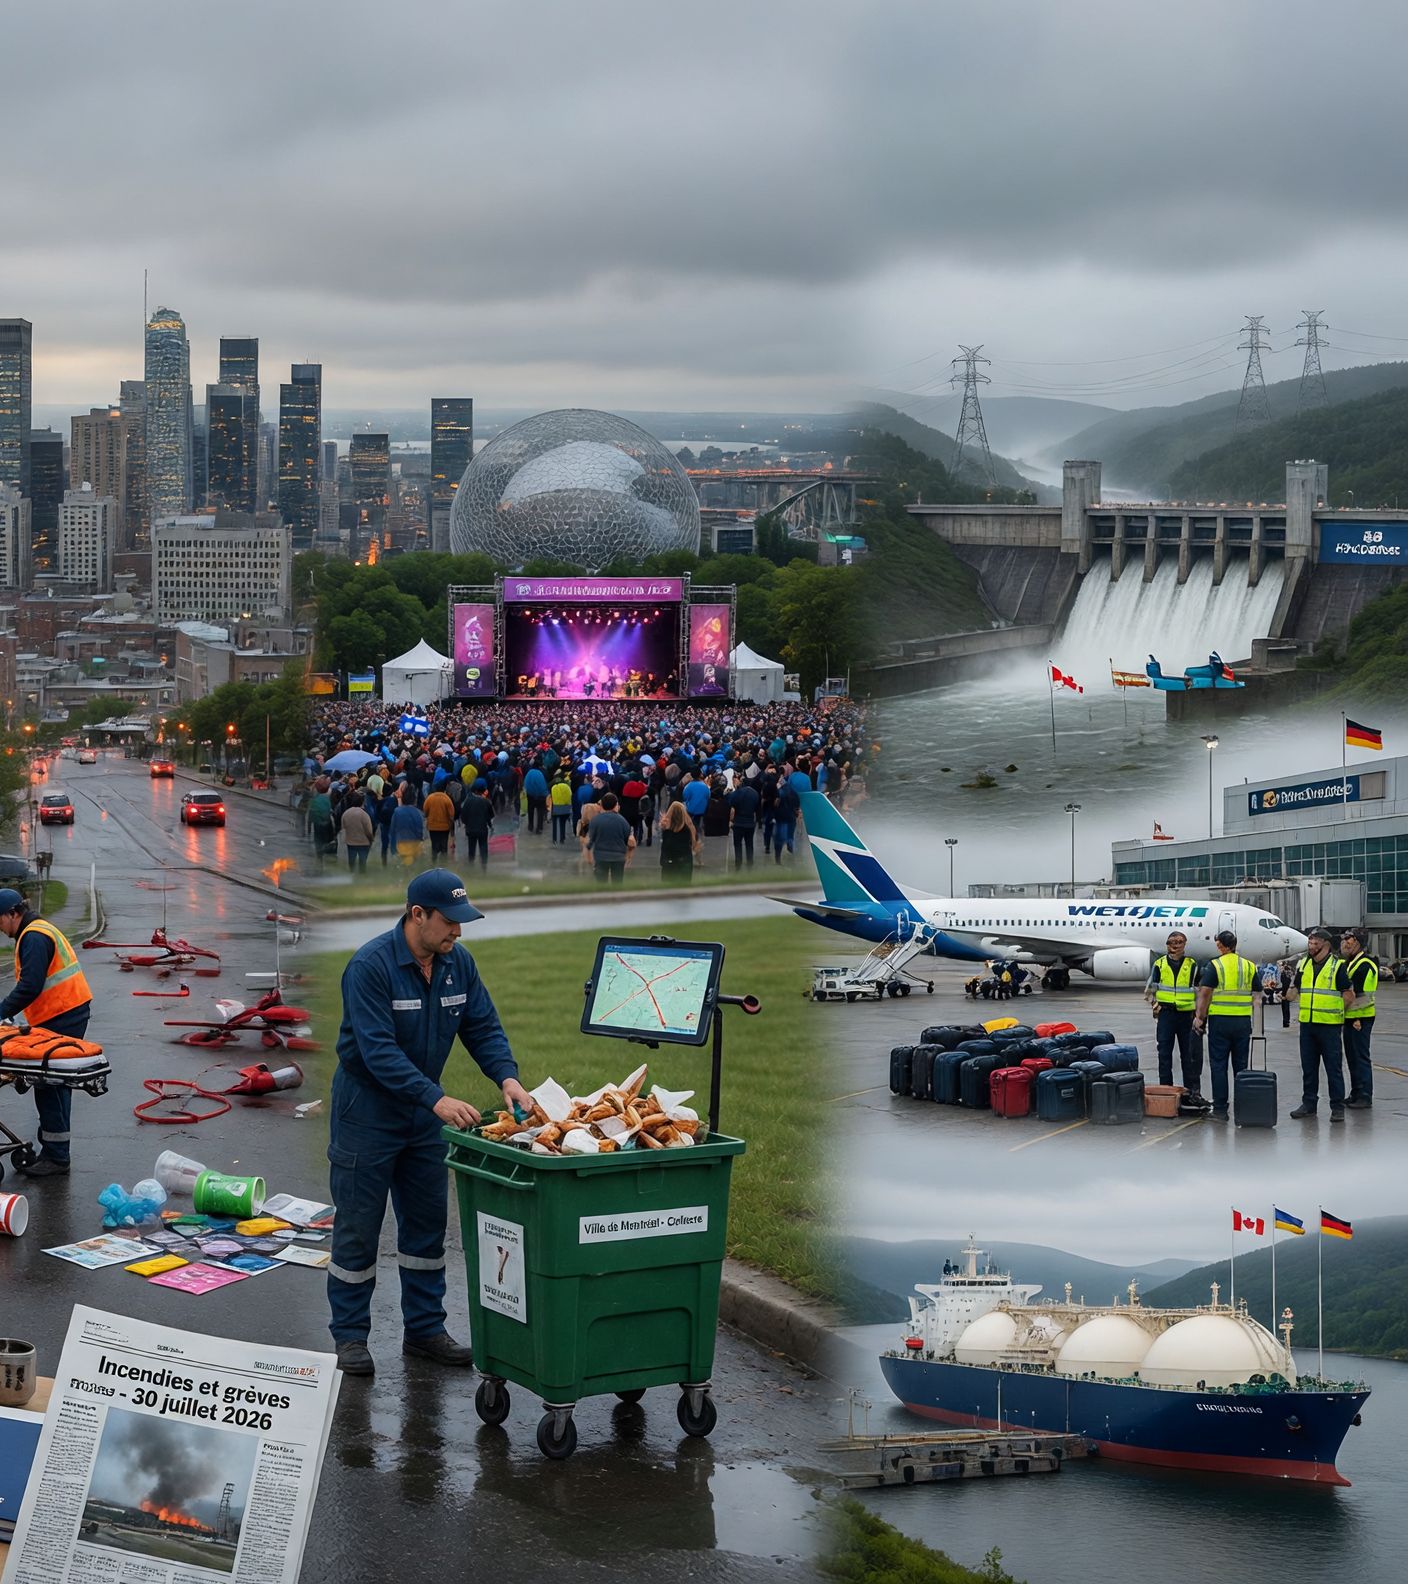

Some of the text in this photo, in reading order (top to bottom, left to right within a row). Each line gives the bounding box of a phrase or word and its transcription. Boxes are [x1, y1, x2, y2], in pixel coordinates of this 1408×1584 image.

[98, 1355, 193, 1392] Incendies
[199, 1380, 220, 1397] et
[222, 1385, 291, 1409] grèves
[132, 1387, 159, 1408] 30
[158, 1393, 219, 1421] juillet
[221, 1406, 273, 1431] 2026
